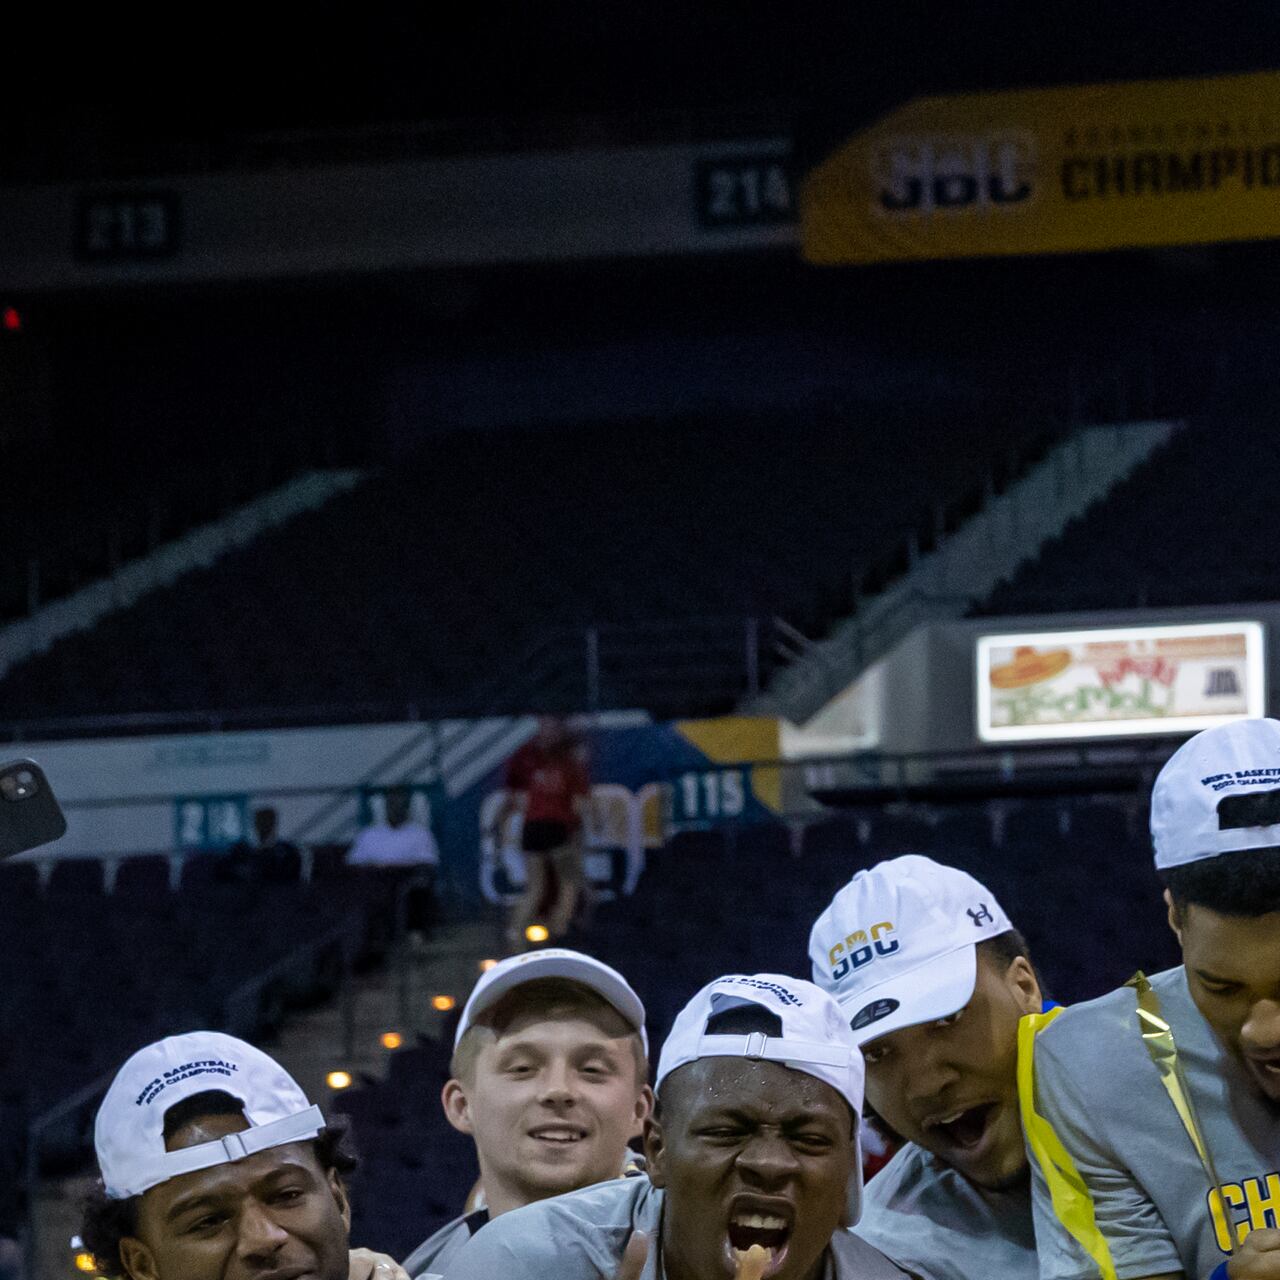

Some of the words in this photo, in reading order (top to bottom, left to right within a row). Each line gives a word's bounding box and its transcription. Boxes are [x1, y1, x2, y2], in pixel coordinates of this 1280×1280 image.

[682, 767, 746, 818] 115
[828, 920, 901, 981] SBC
[136, 1078, 162, 1106] MEN'S
[163, 1060, 238, 1079] BASKETBALL
[165, 1067, 232, 1086] CHAMPIONS
